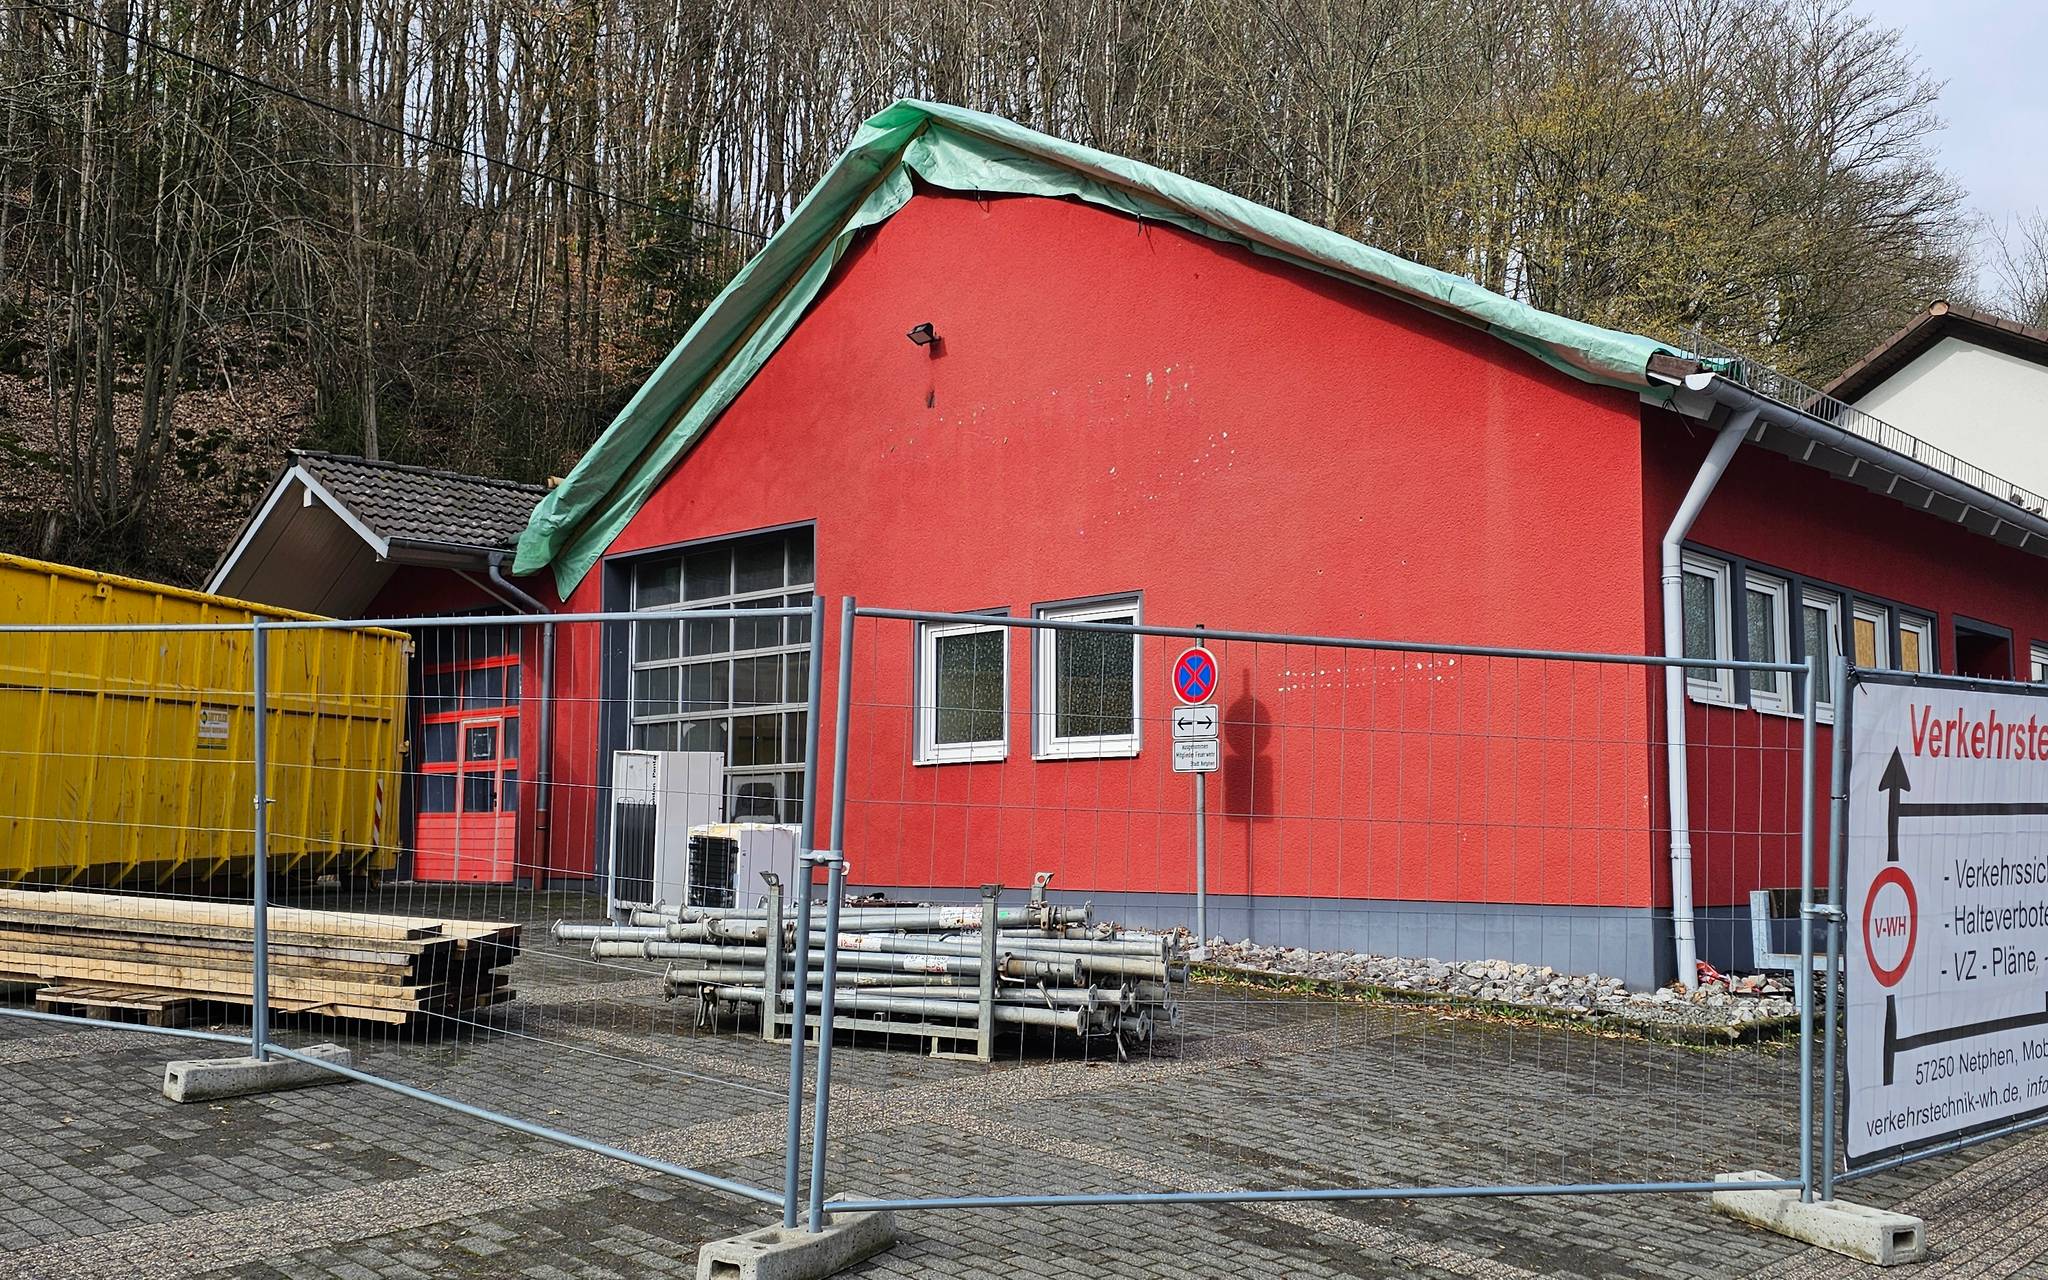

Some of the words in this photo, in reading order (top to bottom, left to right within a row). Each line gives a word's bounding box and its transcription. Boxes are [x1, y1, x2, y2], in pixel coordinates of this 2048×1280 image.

[1910, 703, 2048, 760] Verkehrste
[1874, 916, 1907, 938] V-WH
[1954, 950, 1977, 982] VZ
[1992, 945, 2039, 977] Pläne,
[1915, 1056, 1955, 1086] 57250
[1959, 1048, 2019, 1075] Netphen,
[1866, 1085, 2023, 1137] verkehrstechnik-wh.de,
